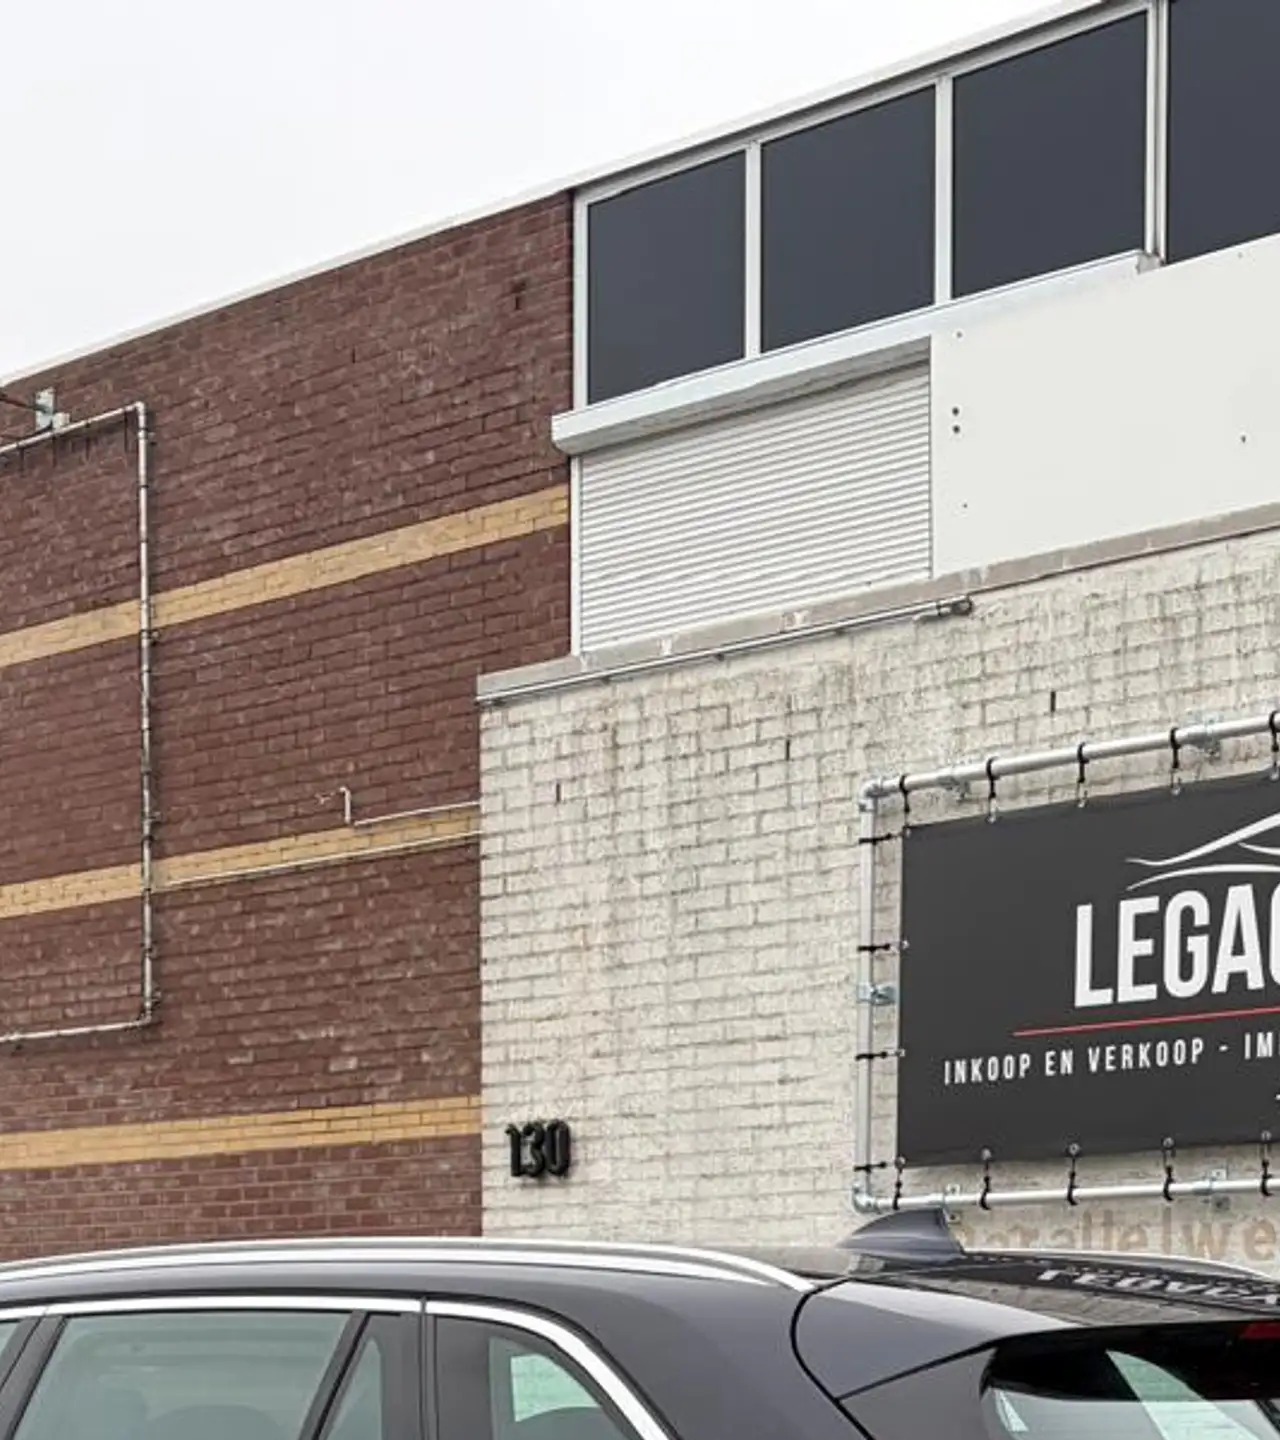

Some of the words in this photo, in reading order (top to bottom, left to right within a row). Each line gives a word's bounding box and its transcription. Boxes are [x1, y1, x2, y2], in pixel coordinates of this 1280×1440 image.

[944, 1053, 1031, 1085] INKOOP
[1045, 1049, 1073, 1076] EN
[1087, 1037, 1204, 1073] VERKOOP
[504, 1119, 571, 1180] 130
